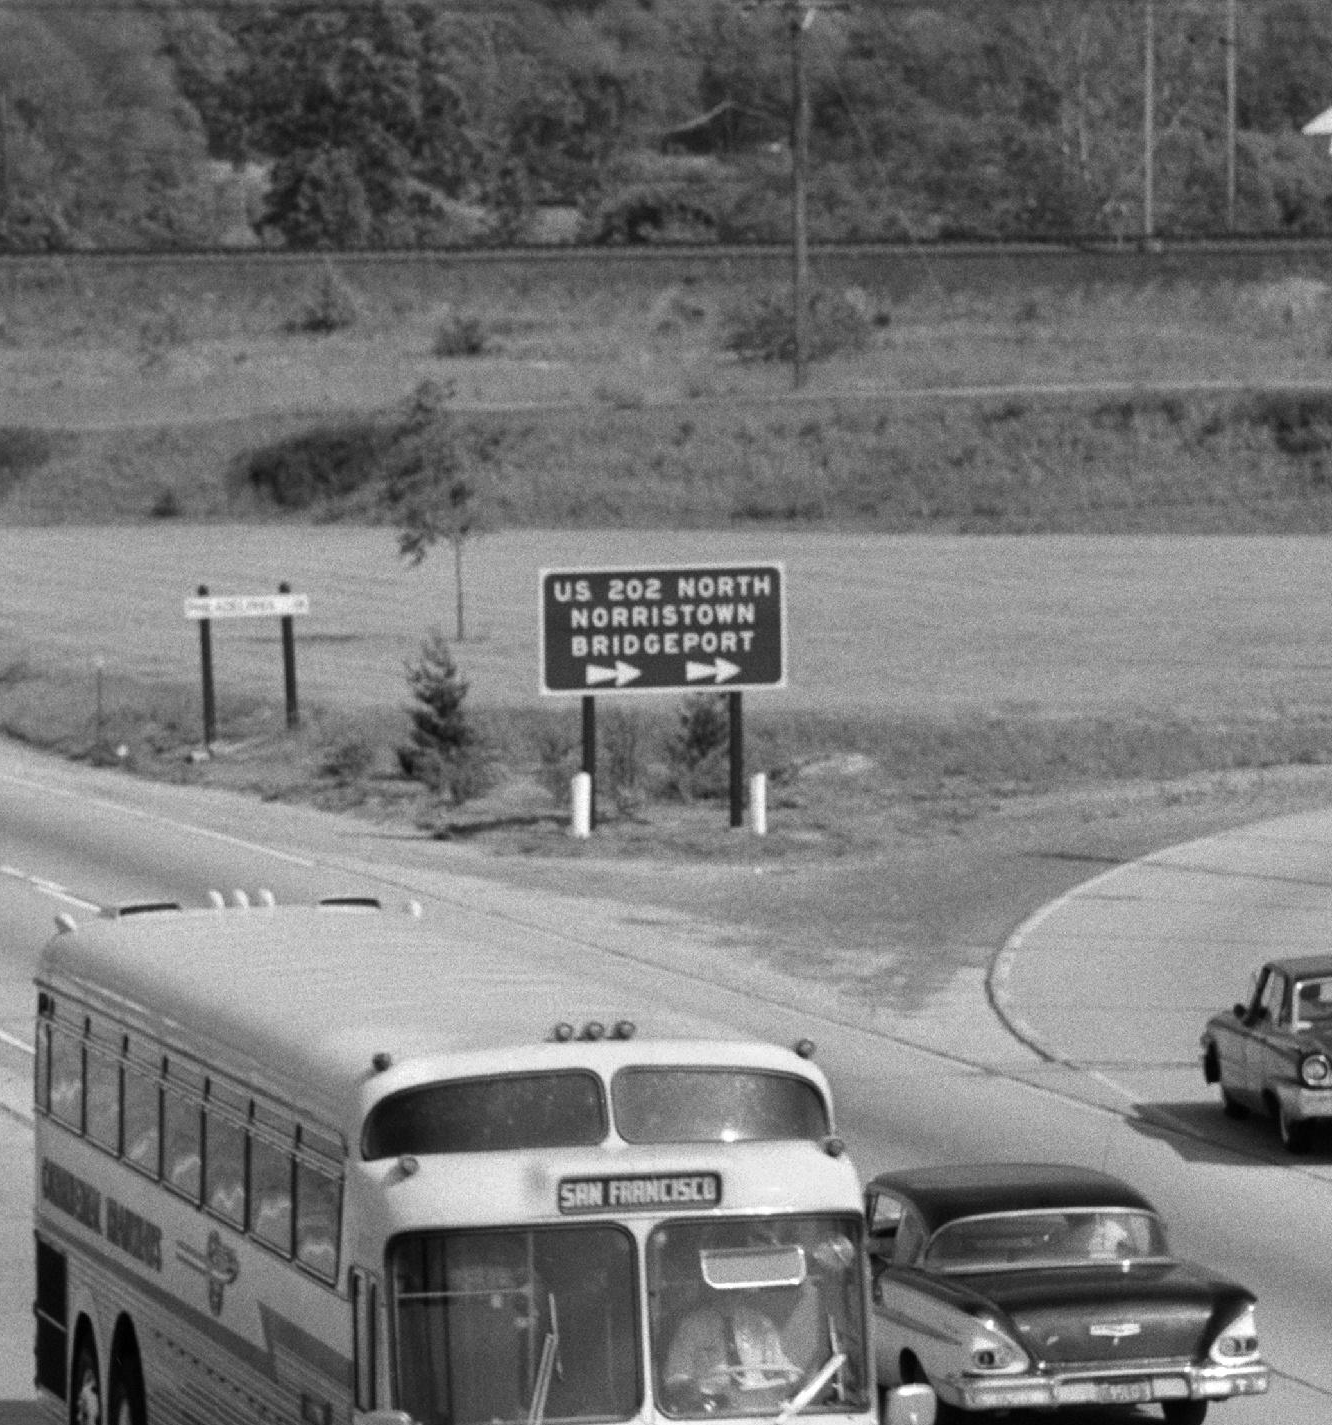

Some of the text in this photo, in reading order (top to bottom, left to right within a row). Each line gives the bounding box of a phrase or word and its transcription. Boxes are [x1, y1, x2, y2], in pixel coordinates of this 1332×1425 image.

[553, 575, 771, 602] US 202 NORTH
[570, 602, 755, 629] NORRISTOWN
[570, 630, 755, 657] BRIDGEPORT
[560, 1177, 717, 1207] SAN FRANCISCO
